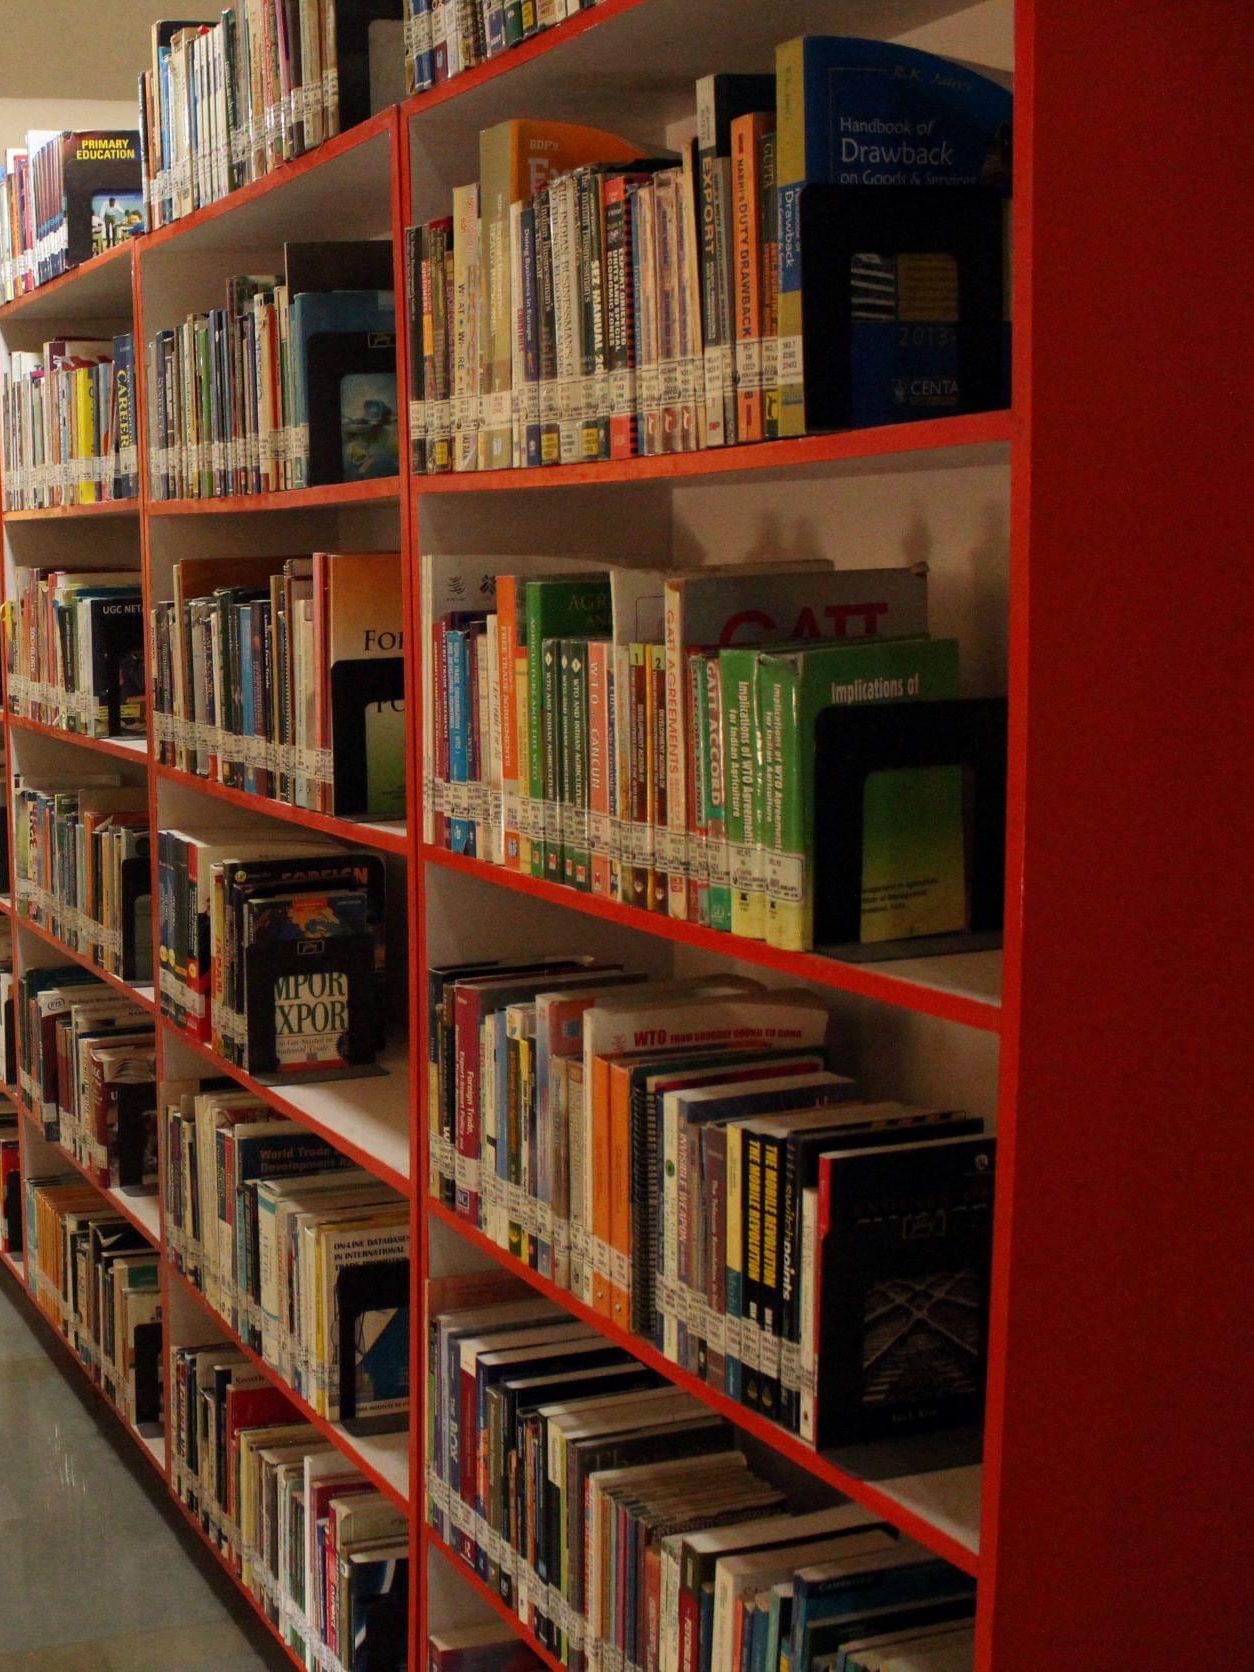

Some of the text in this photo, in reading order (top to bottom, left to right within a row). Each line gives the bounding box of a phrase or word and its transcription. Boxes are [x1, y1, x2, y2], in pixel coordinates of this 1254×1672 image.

[82, 138, 130, 150] PRIMARY
[840, 116, 935, 136] Handbook of
[76, 149, 136, 160] EDUCATION
[841, 137, 954, 166] Drawback
[702, 156, 715, 254] EXPORT
[738, 203, 750, 244] DUTY
[784, 190, 796, 268] Drawback
[540, 205, 553, 312] Indian Businessman's
[560, 211, 569, 256] INDIAN
[562, 260, 573, 360] BUSINESSMAN'S
[590, 260, 603, 350] SEZ MANUAL
[740, 249, 752, 338] DRAWBACK
[117, 369, 131, 448] CAREER
[102, 605, 122, 615] UGC
[572, 678, 580, 698] WTO
[666, 610, 678, 774] GATT AGREEMENTS
[738, 681, 751, 744] Implications
[832, 672, 920, 704] Implications of
[574, 720, 582, 750] INDIAN
[706, 662, 720, 806] GATT ACCORD
[772, 683, 782, 751] Implications
[590, 728, 600, 788] CANCUN
[729, 709, 741, 818] for Indian Agriculture
[740, 746, 751, 758] of
[740, 760, 753, 784] WTO
[774, 765, 782, 788] WTO
[766, 766, 774, 822] Agriculture
[276, 1001, 348, 1036] XPOR
[634, 1029, 667, 1047] WTO
[670, 1032, 692, 1044] FROM
[765, 1028, 776, 1038] TO
[458, 1110, 466, 1136] Policy
[465, 1070, 475, 1136] Foreign Trade,
[678, 1132, 688, 1244] INVISIBLE WEAPON
[747, 1140, 761, 1282] THE MOBILE REVOLUTION
[763, 1144, 778, 1288] THE MOBILE REVOLUTION
[334, 1240, 364, 1251] ON-LINE
[345, 1247, 404, 1260] INTERNATIONAL
[782, 1184, 795, 1301] switchpoints
[450, 1419, 458, 1464] BOX
